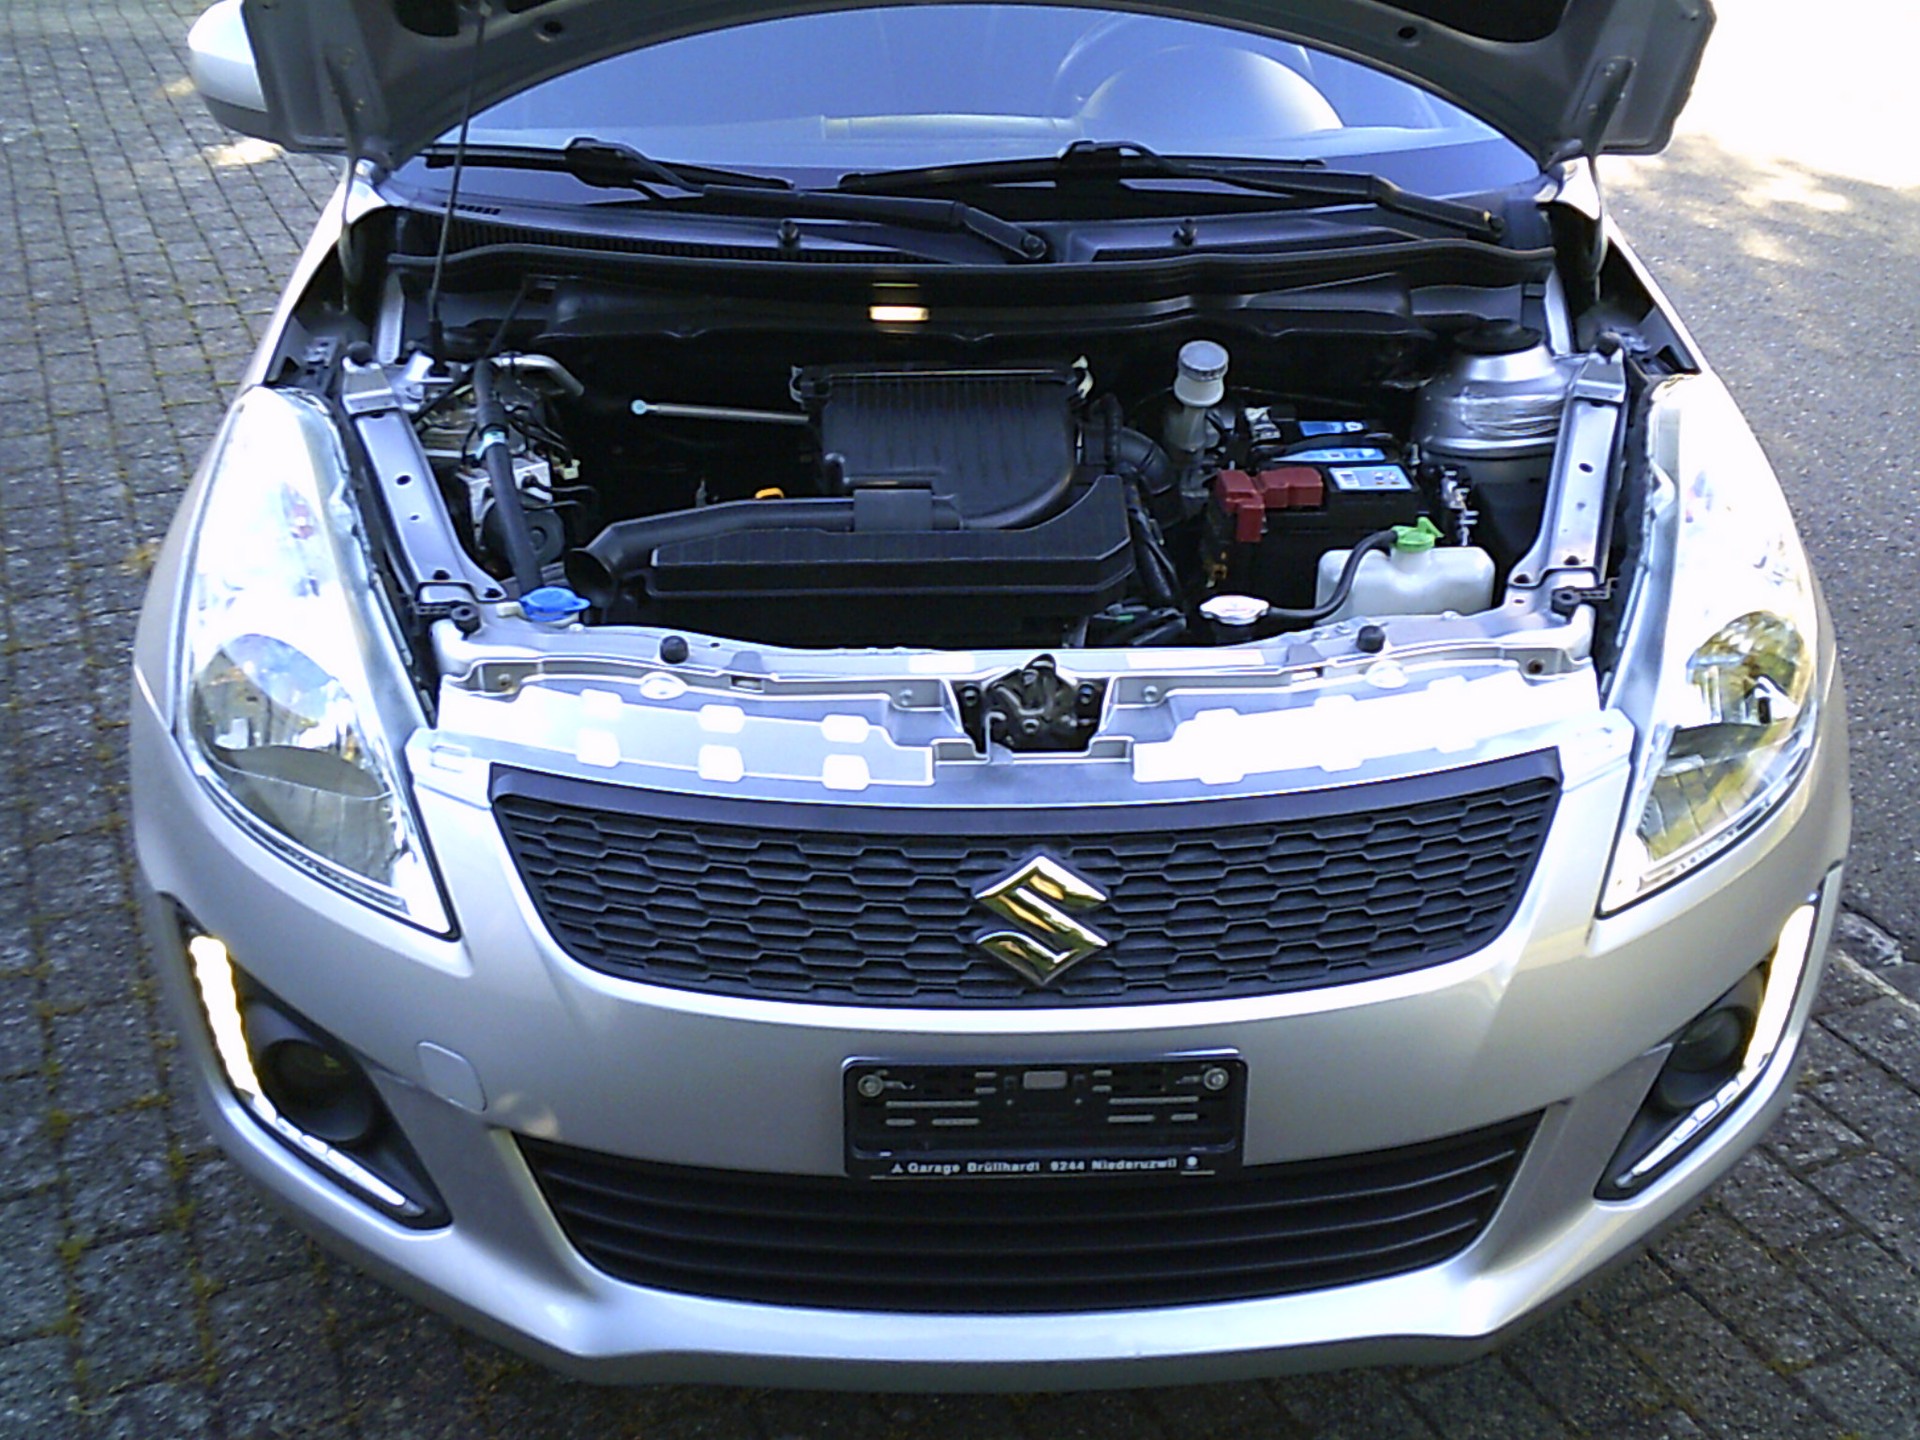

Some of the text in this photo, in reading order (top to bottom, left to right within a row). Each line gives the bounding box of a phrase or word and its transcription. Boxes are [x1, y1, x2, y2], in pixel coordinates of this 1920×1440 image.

[907, 1161, 961, 1175] Garage
[1050, 1160, 1085, 1172] 9244
[1091, 1157, 1178, 1171] Niederuzwil
